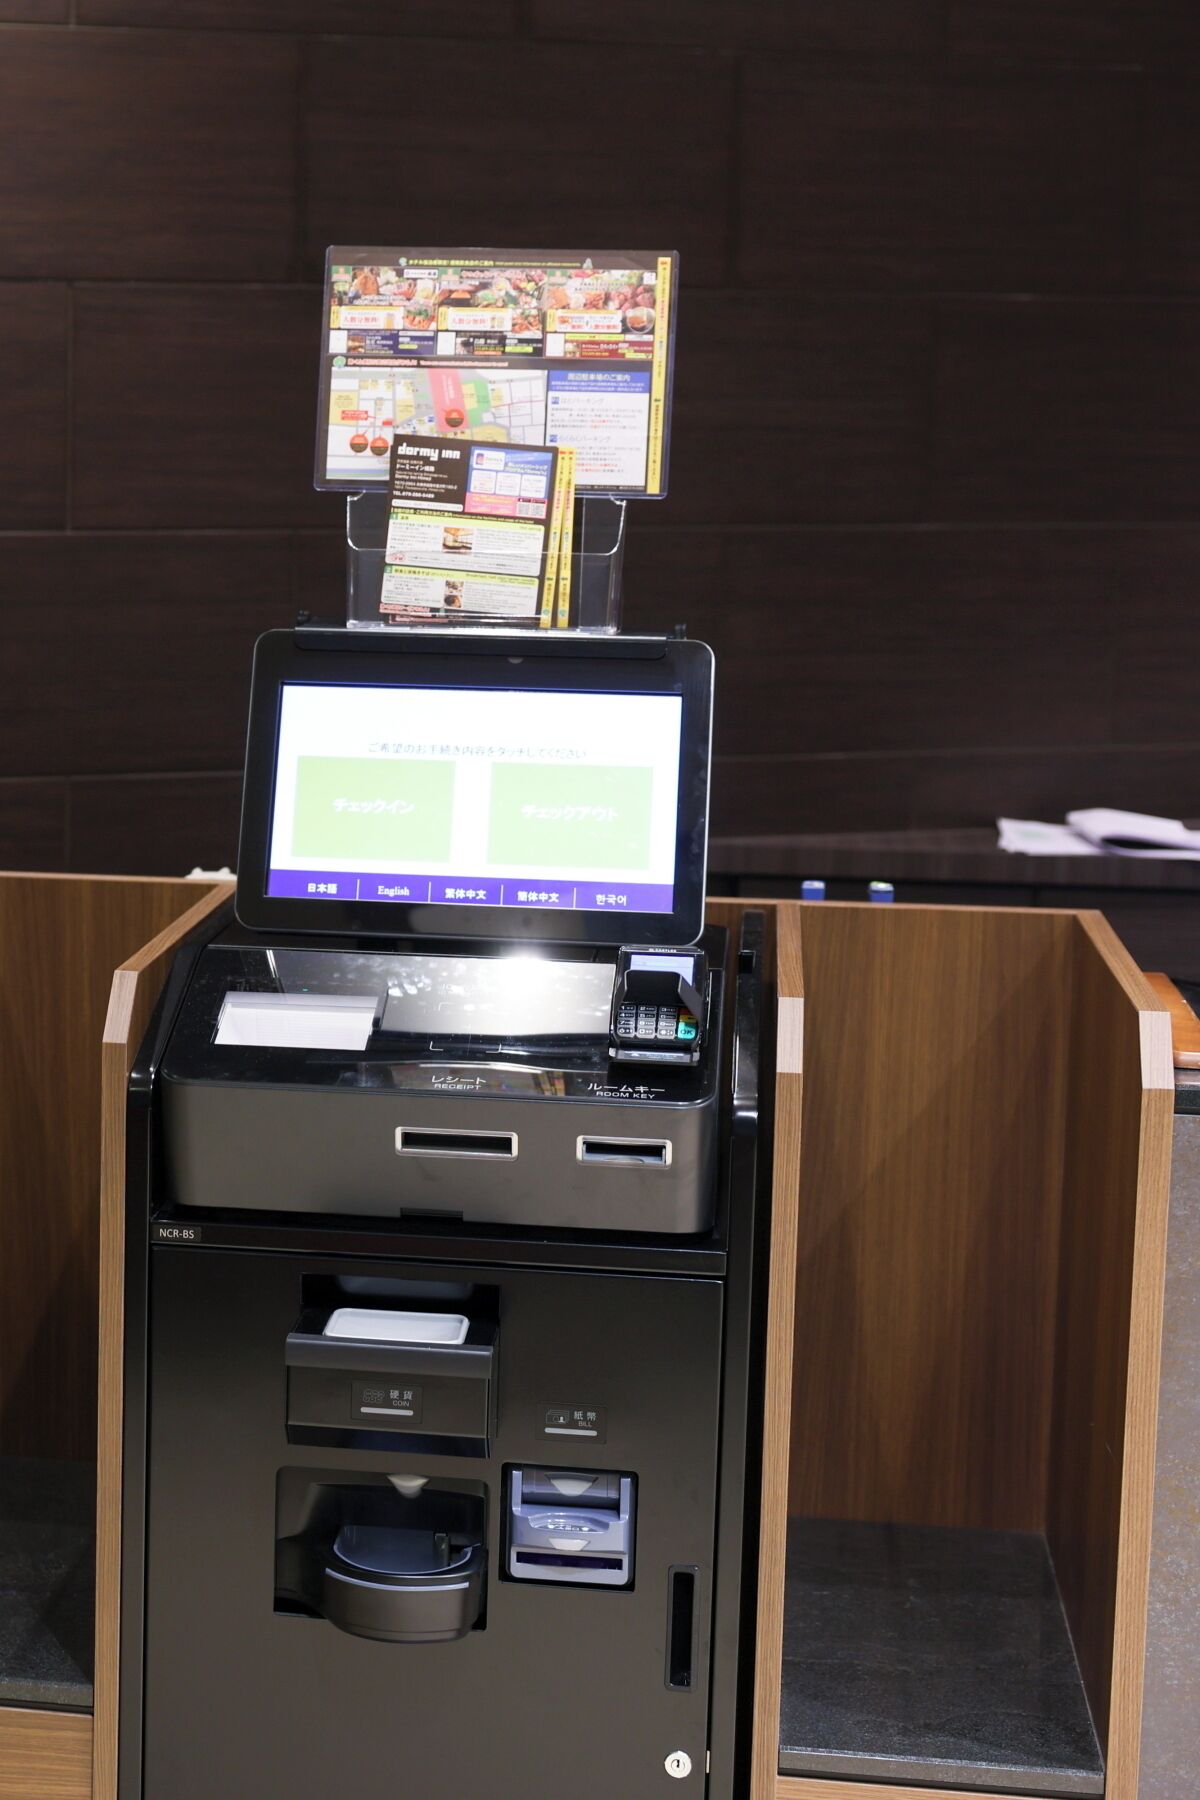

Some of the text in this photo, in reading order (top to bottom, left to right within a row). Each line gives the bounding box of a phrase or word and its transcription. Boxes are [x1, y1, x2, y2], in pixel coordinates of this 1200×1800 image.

[397, 442, 461, 461] dormy inn
[331, 797, 620, 822] チェックイン チェックアウト
[307, 882, 337, 895] 日本語
[377, 884, 410, 897] English
[595, 893, 628, 907] 한국어
[431, 1075, 486, 1085] レシート
[434, 1083, 482, 1091] RECEIPT
[588, 1082, 665, 1093] ルームキー
[632, 1092, 656, 1100] KEY
[159, 1228, 195, 1239] NCR-BS
[389, 1388, 413, 1400] 硬貨
[573, 1410, 597, 1422] 紙幣
[578, 1420, 593, 1428] BILL
